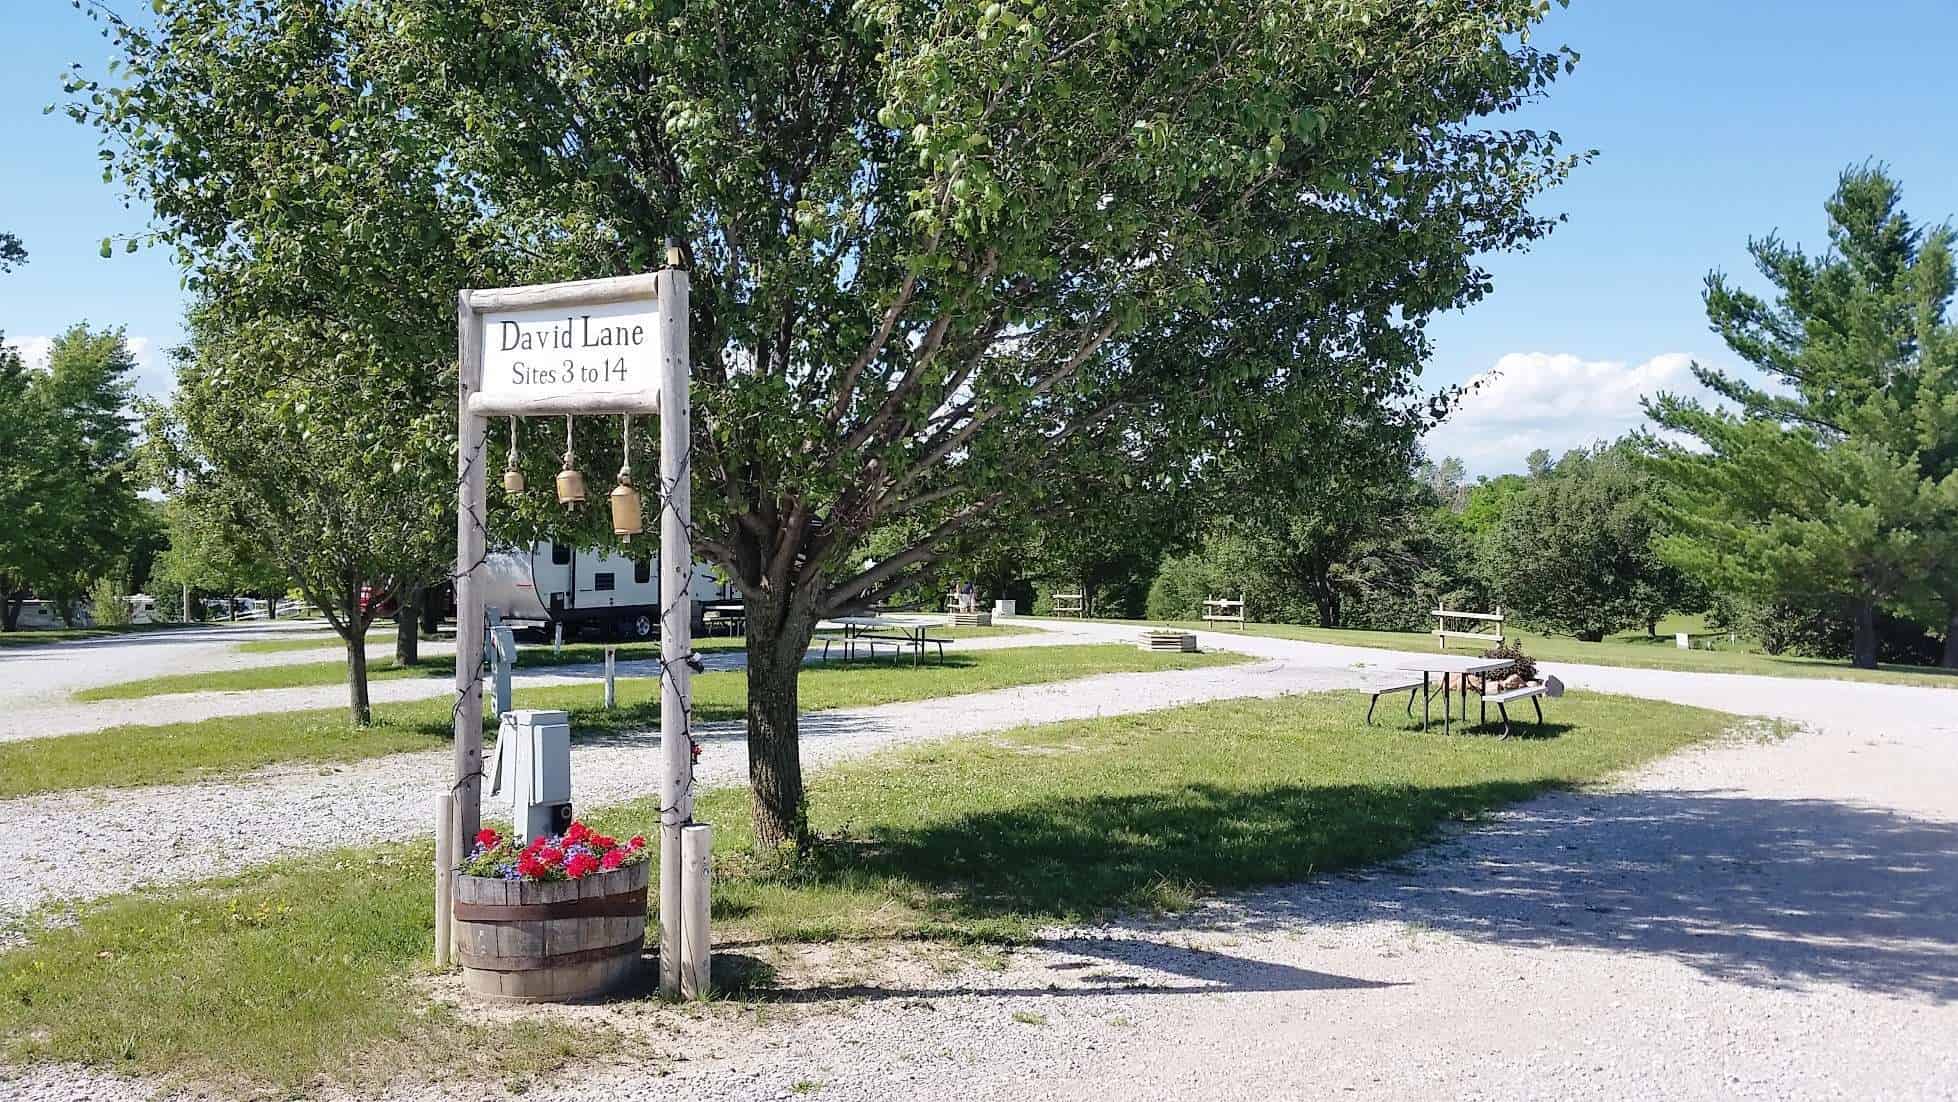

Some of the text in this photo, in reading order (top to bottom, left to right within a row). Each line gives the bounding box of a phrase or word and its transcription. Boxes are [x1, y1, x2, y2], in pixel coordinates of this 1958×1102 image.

[500, 315, 644, 351] David Lane
[512, 357, 628, 385] Sites 3 to 14
